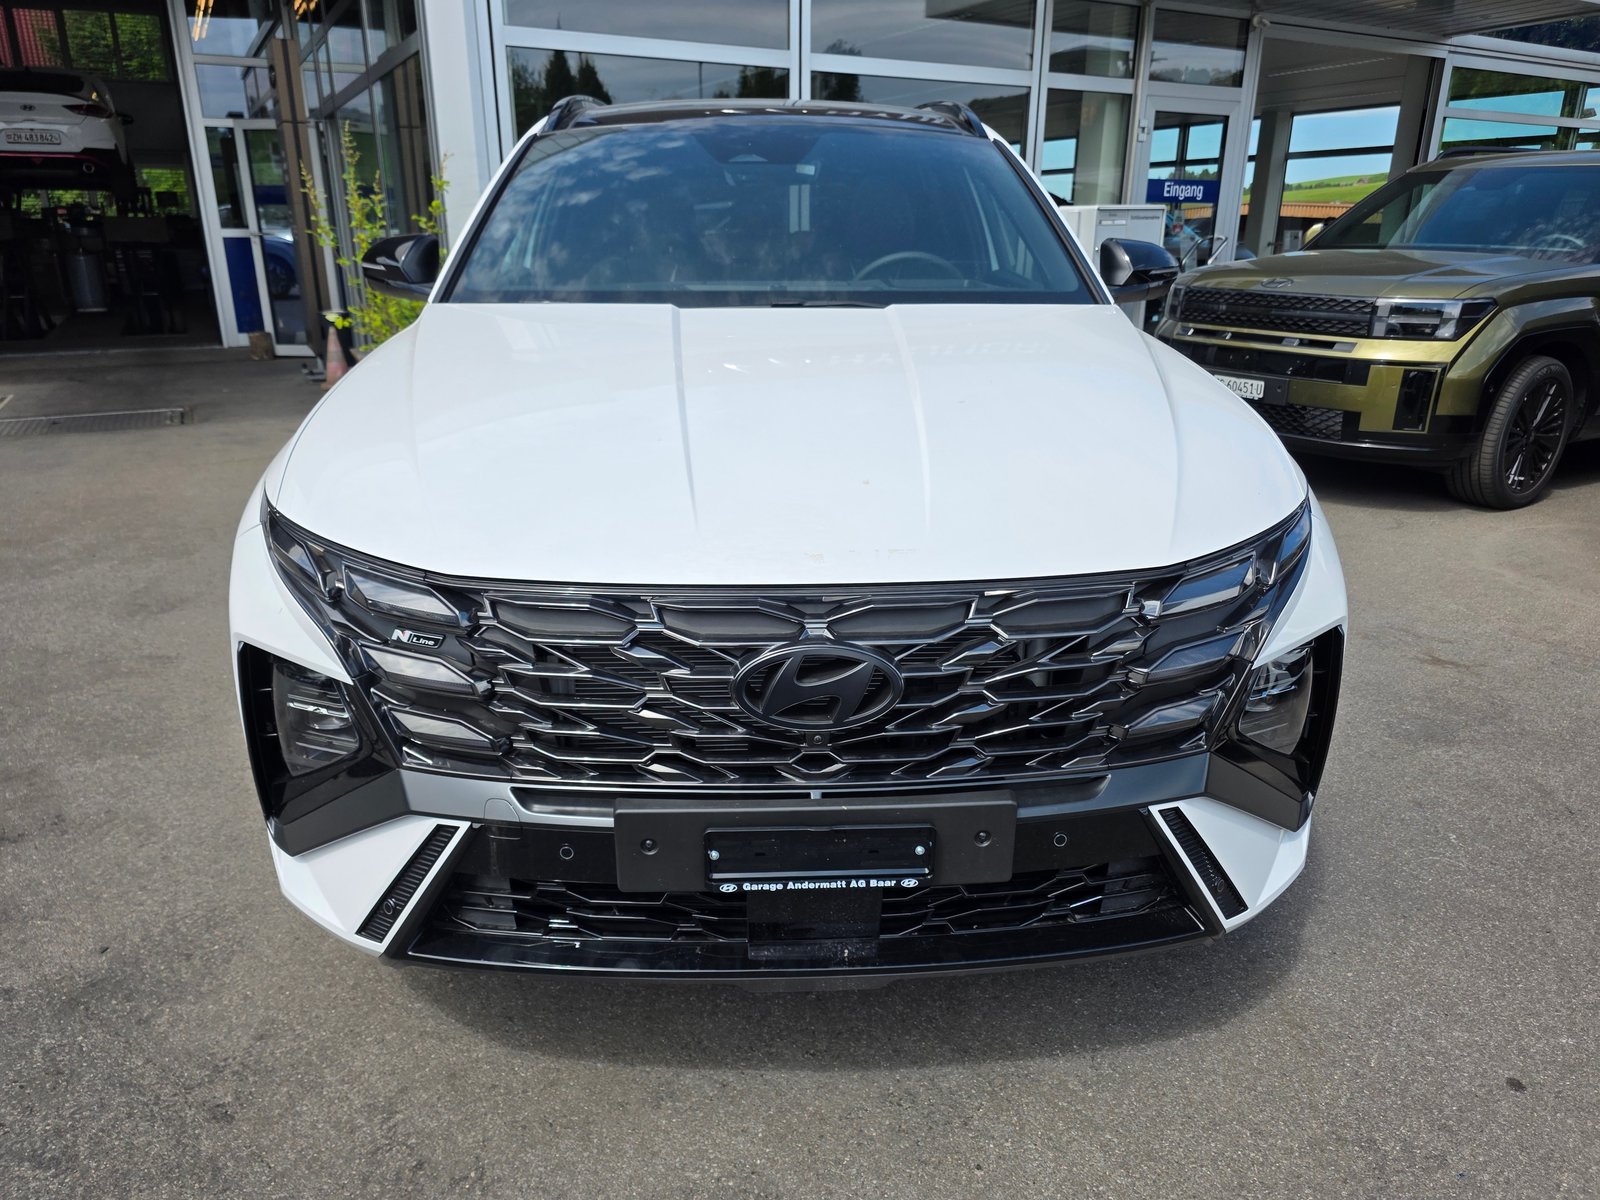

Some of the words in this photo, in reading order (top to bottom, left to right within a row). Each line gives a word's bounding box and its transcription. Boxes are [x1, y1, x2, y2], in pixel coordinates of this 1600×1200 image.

[1164, 182, 1203, 200] Eingang
[391, 629, 412, 643] N
[412, 637, 435, 646] Line
[743, 882, 783, 891] Garage
[787, 880, 846, 889] Andermatt
[850, 879, 866, 888] AG
[870, 879, 896, 887] Baar
